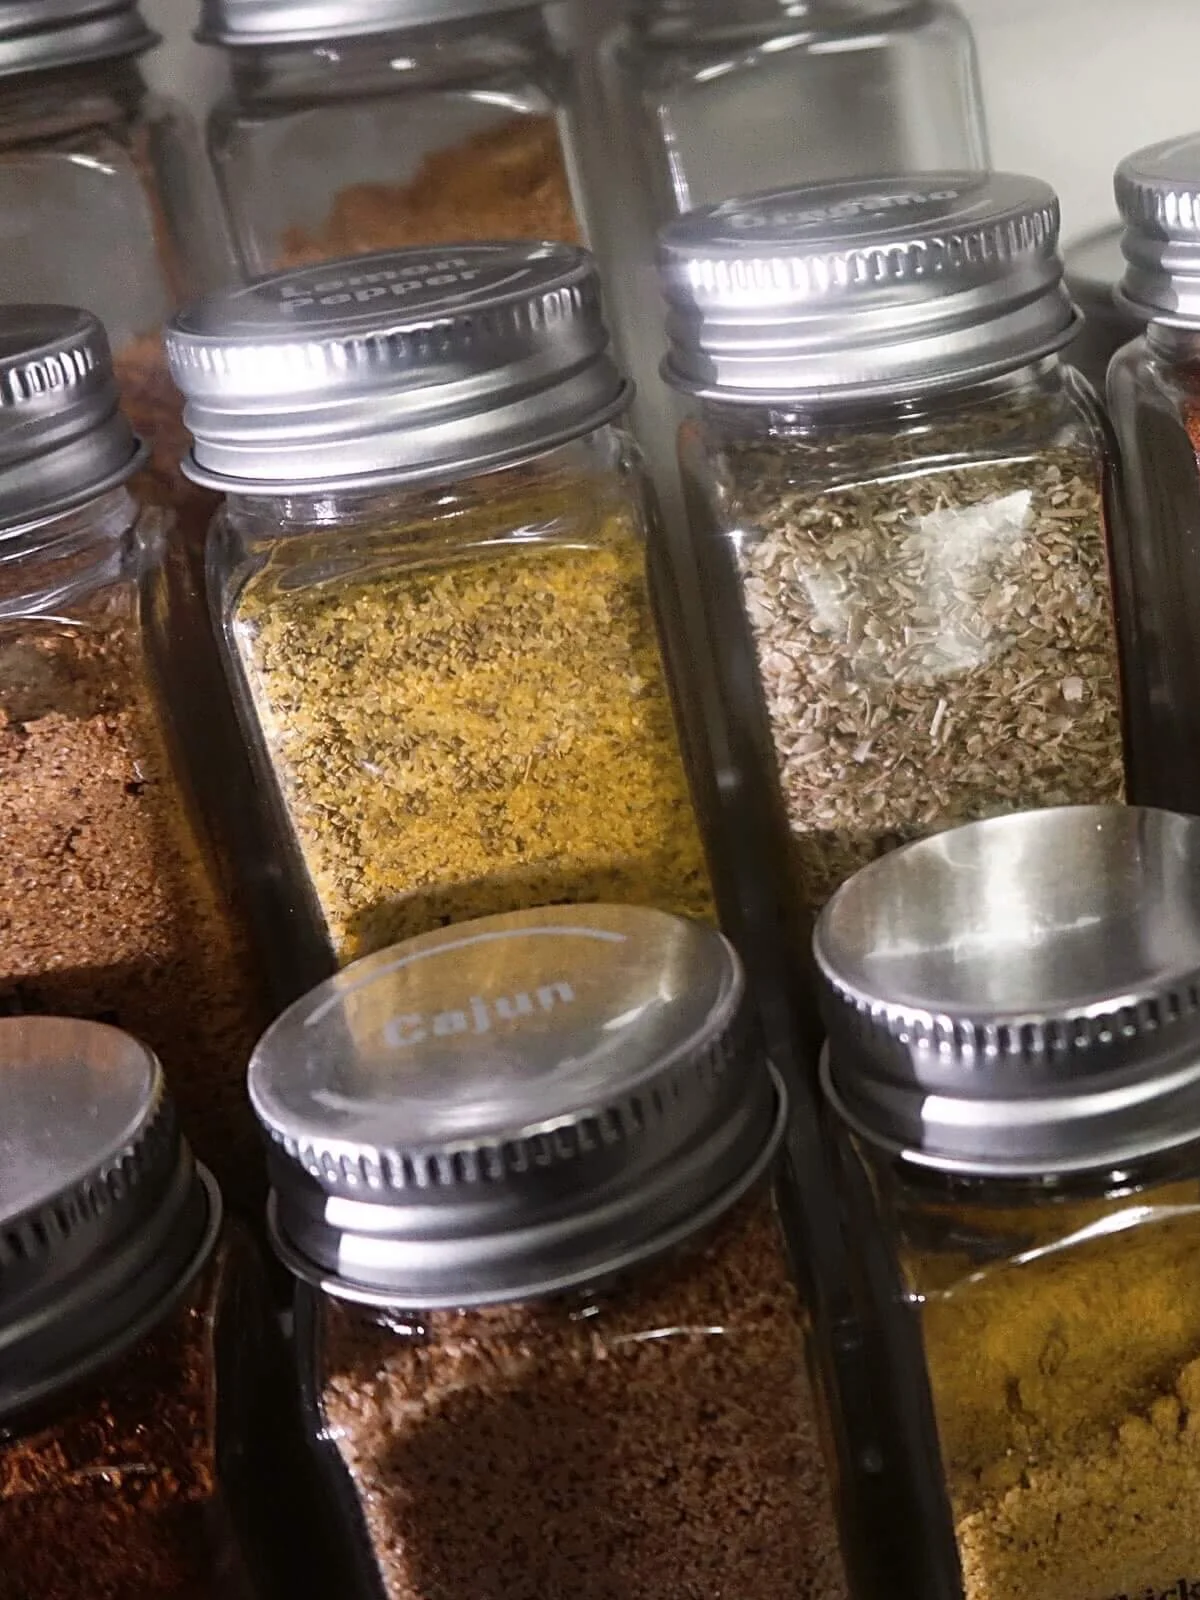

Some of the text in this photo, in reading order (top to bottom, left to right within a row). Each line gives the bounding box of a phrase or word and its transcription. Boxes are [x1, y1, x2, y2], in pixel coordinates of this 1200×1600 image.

[279, 257, 467, 299] Lemon
[279, 268, 481, 313] Pepper
[382, 981, 575, 1048] Cajun
